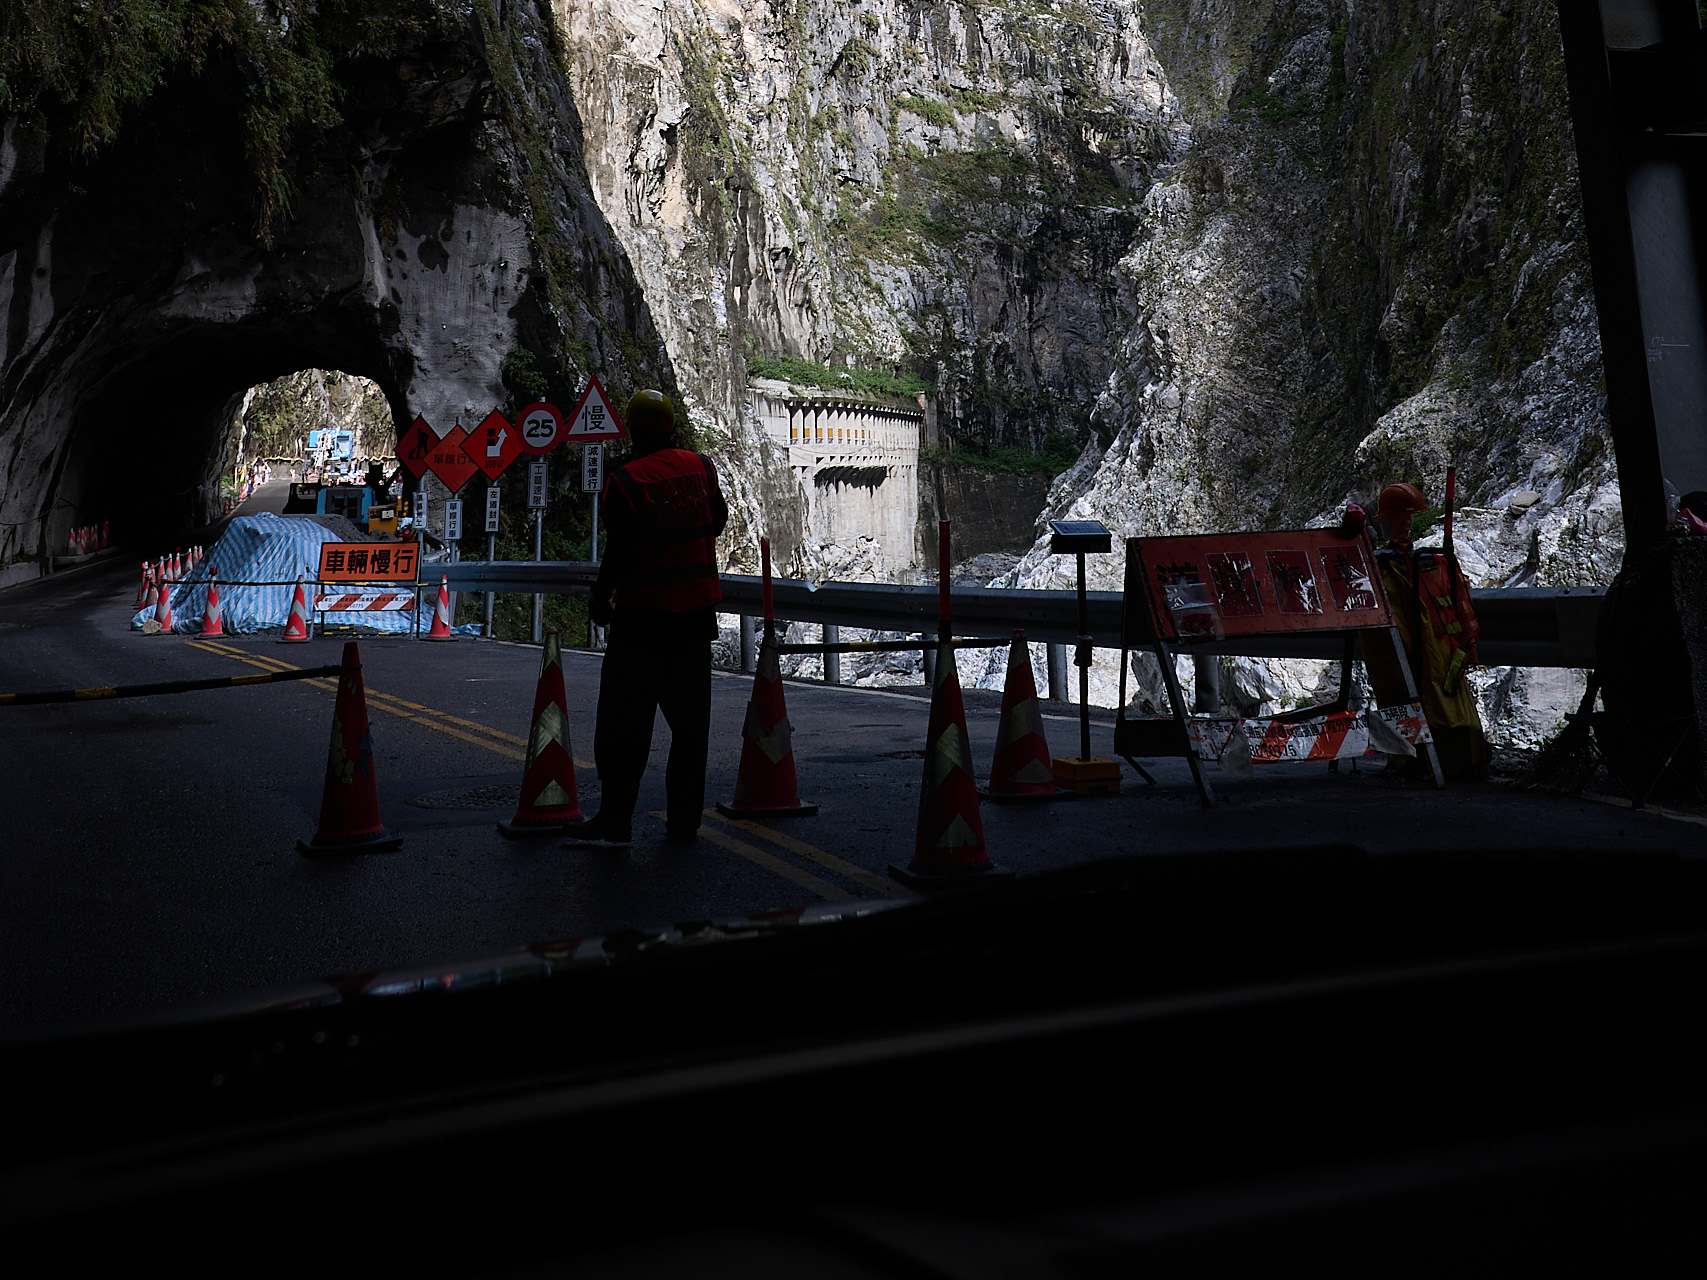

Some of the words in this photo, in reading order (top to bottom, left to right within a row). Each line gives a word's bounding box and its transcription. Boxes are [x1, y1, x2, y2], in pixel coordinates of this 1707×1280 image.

[526, 419, 554, 438] 25
[581, 405, 606, 432] 慢
[433, 453, 475, 465] 單線行
[587, 446, 599, 489] 減速慢行
[532, 466, 543, 506] 工區速限
[448, 502, 458, 538] 單線行車
[488, 490, 498, 530] 左道封閉
[324, 549, 414, 574] 車輛慢行
